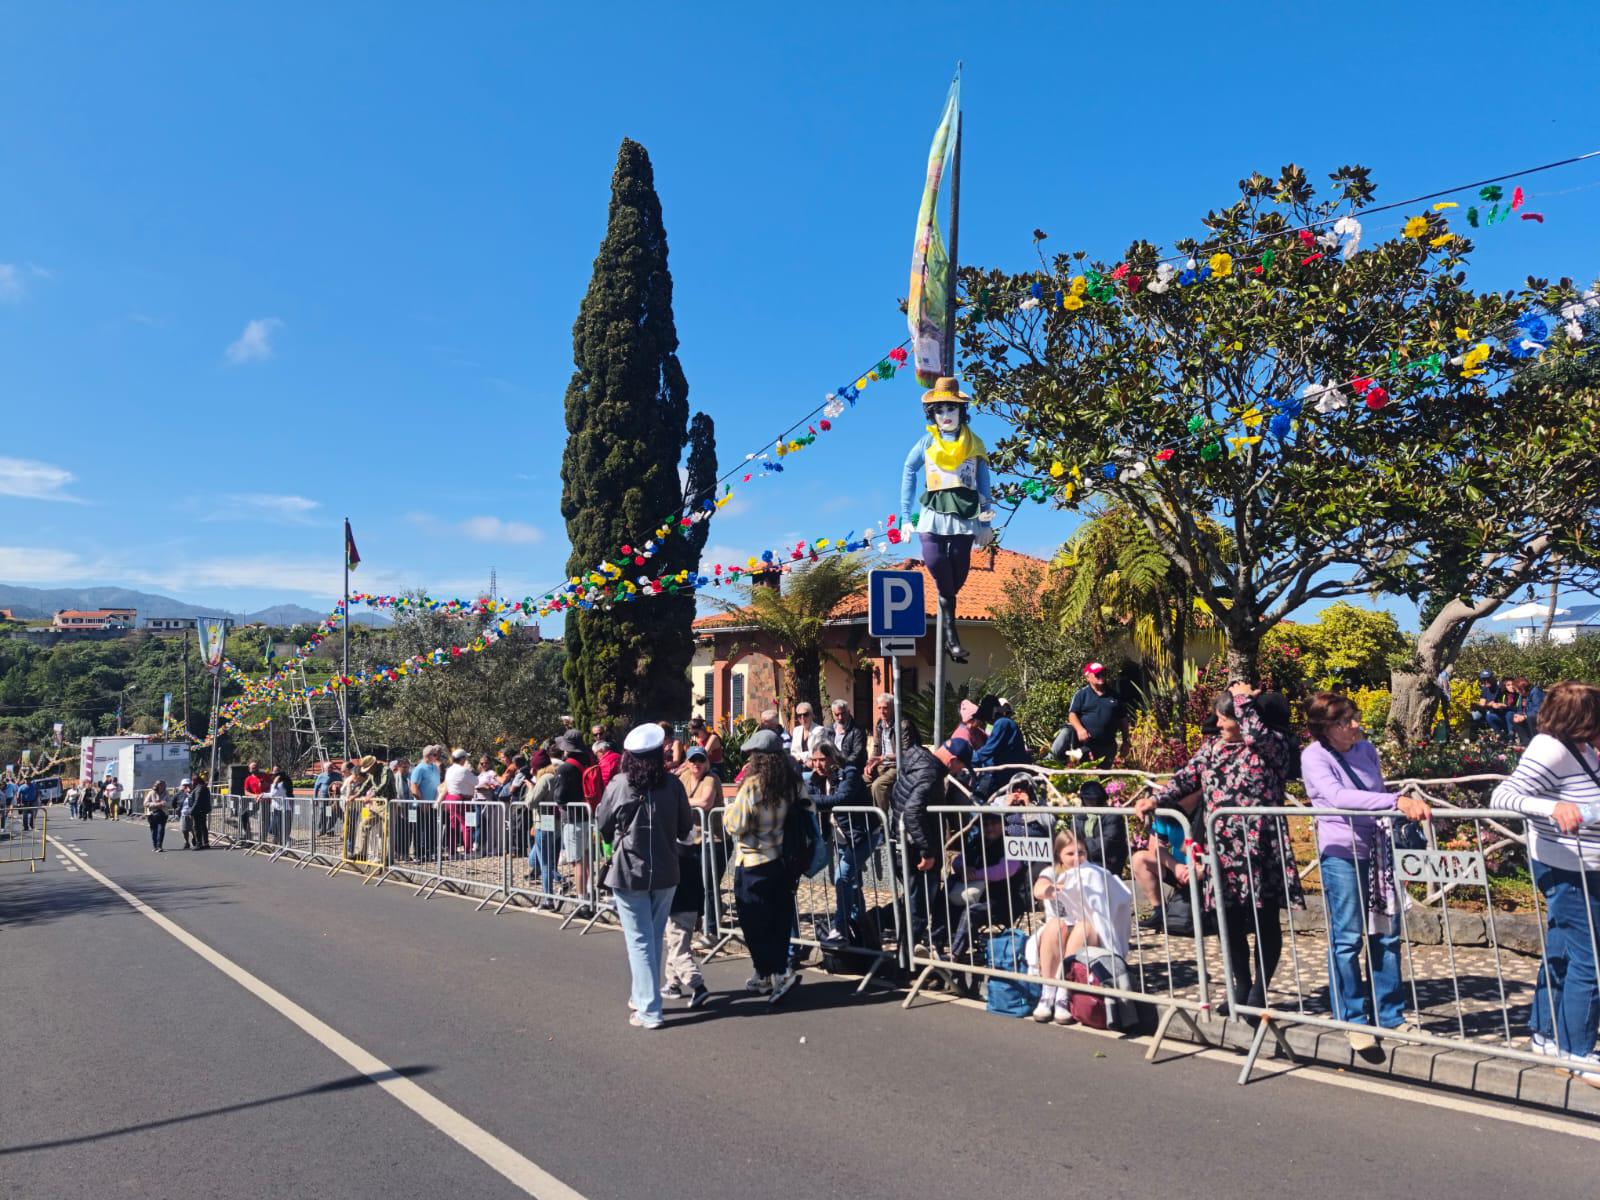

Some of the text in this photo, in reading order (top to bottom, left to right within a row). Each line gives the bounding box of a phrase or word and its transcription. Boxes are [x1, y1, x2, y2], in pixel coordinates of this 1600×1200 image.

[883, 578, 913, 629] P
[1008, 840, 1049, 858] CMM
[1401, 854, 1479, 879] CMM
